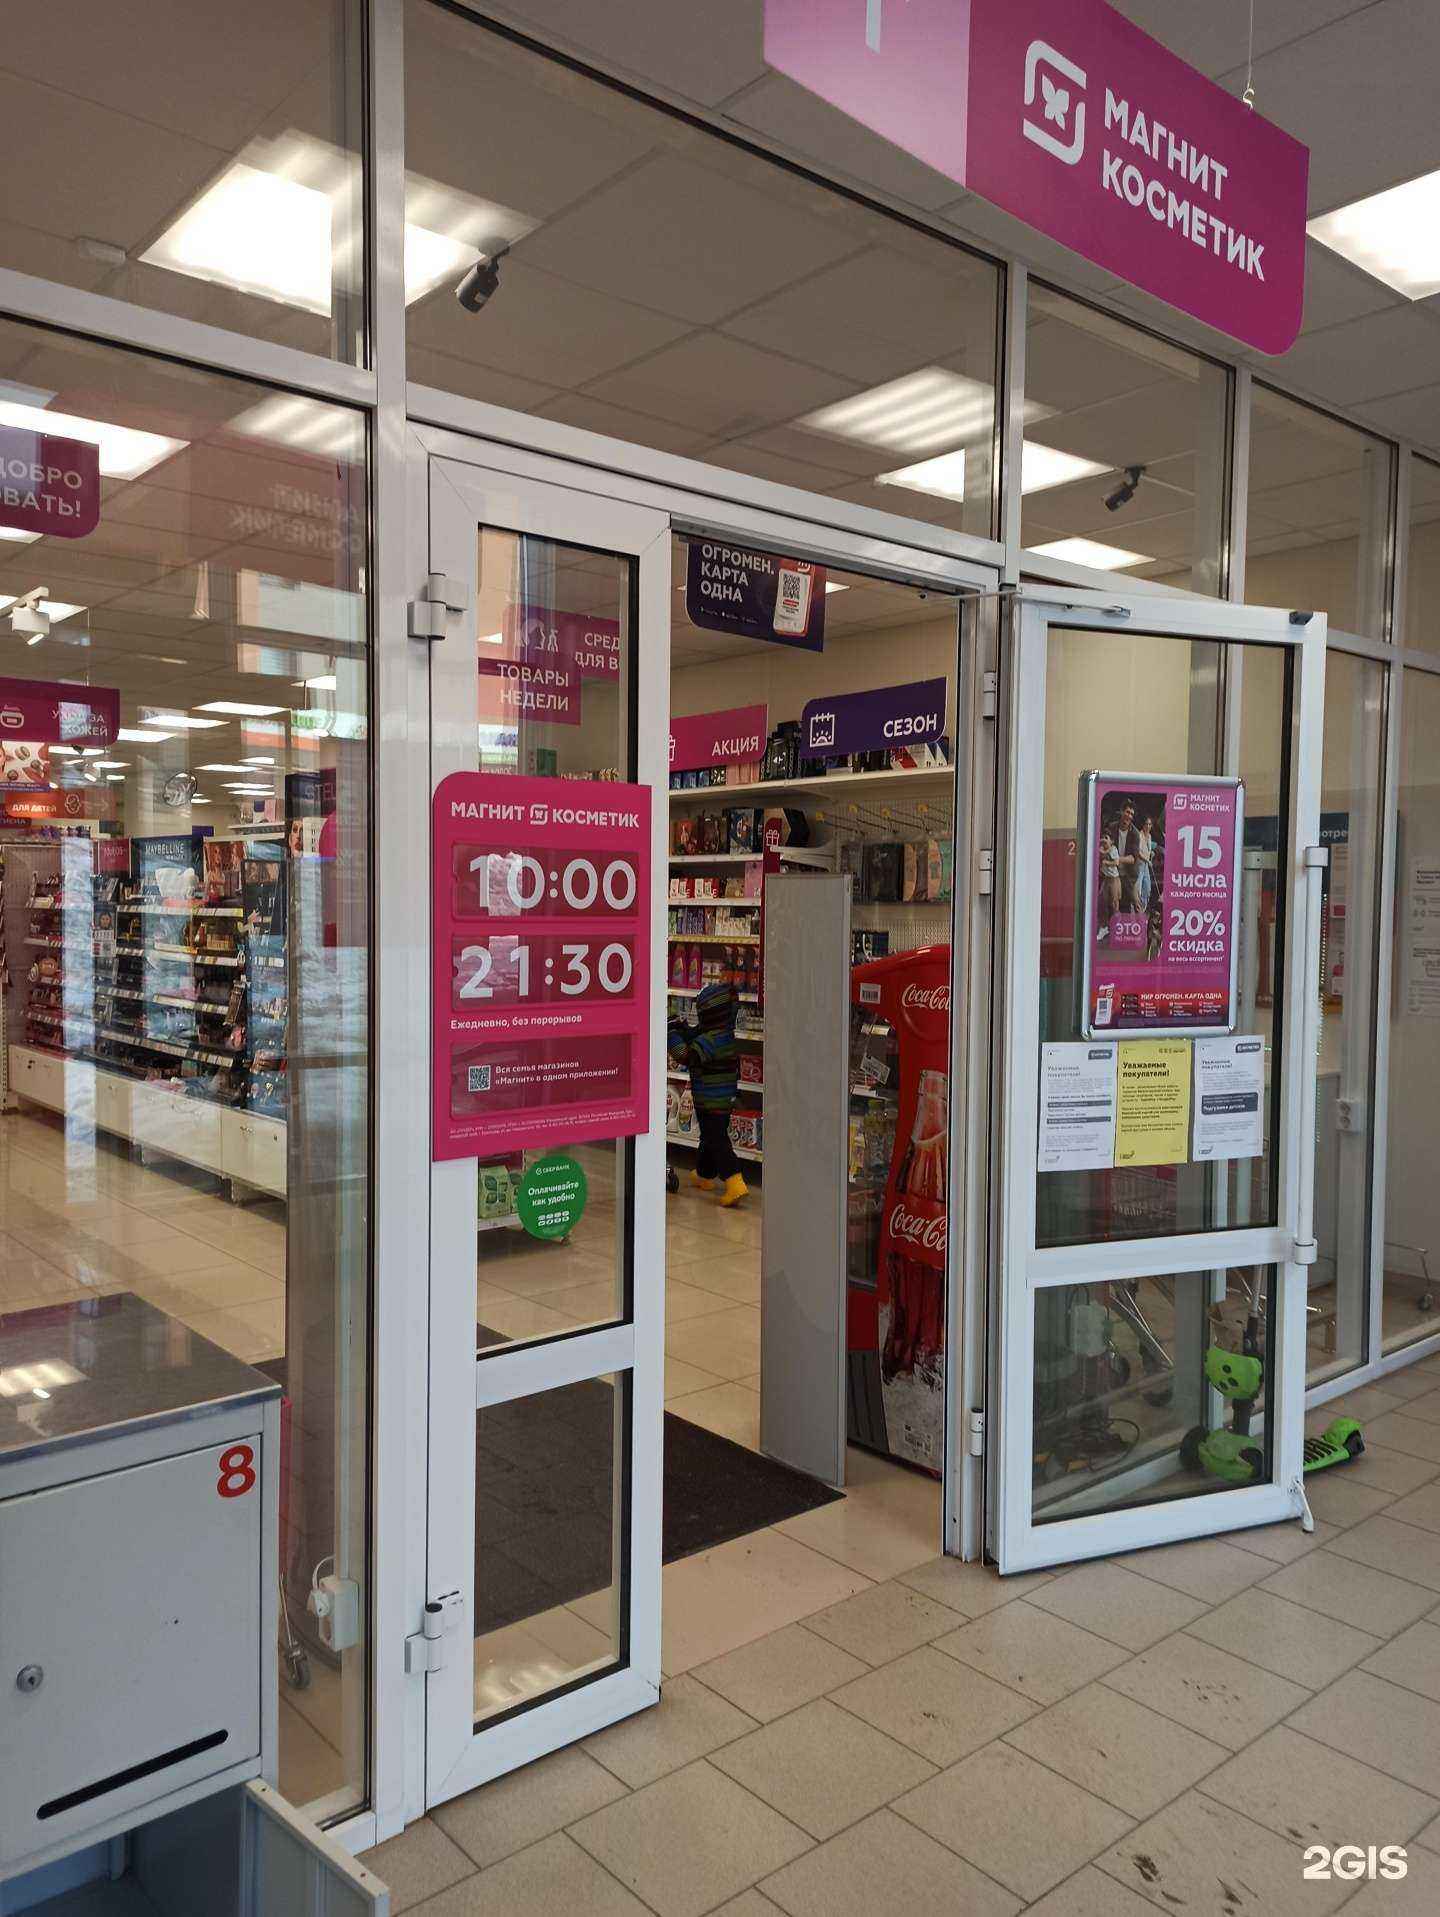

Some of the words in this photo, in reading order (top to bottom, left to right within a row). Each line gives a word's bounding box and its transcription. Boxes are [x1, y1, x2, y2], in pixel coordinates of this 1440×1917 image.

[1104, 88, 1228, 200] МАГНИТ
[1102, 148, 1265, 282] КОСМЕТИК
[0, 486, 81, 518] ВАТЬ!
[702, 544, 775, 575] ОГРОМЕН.
[701, 561, 749, 587] КАРТА
[700, 580, 743, 602] ОДНА
[584, 632, 620, 650] СРЕД
[575, 651, 605, 669] ДЛЯ
[609, 657, 620, 670] В
[497, 663, 569, 687] ТОВАРЫ
[499, 689, 569, 712] НЕДЕЛИ
[883, 713, 938, 738] СЕЗОН
[712, 735, 759, 757] АКЦИЯ
[450, 801, 525, 822] МАГНИТ
[552, 808, 640, 828] КОСМЕТИК
[1321, 829, 1348, 839] отре
[145, 843, 185, 855] MAYBELLINE
[1177, 825, 1222, 869] 15
[469, 854, 637, 911] 10:00
[1171, 873, 1227, 889] числа
[1170, 891, 1201, 899] каждого
[1115, 922, 1142, 936] ЭТО
[1169, 909, 1226, 936] 20%
[1169, 940, 1225, 954] скидка
[459, 943, 633, 999] 21:30
[450, 1018, 510, 1030] Ежедневно,
[512, 1016, 528, 1026] без
[531, 1014, 582, 1025] перерывов
[496, 1065, 511, 1074] Вся
[512, 1064, 536, 1073] семья
[537, 1061, 580, 1070] магазинов
[542, 1073, 568, 1081] одном
[569, 1067, 619, 1080] приложении!
[1123, 1061, 1167, 1069] Уважаемые
[1123, 1070, 1170, 1079] покупатели!
[528, 1180, 580, 1196] Оплачивайте
[532, 1198, 546, 1206] как
[547, 1192, 576, 1206] удобно
[217, 1445, 256, 1498] 8
